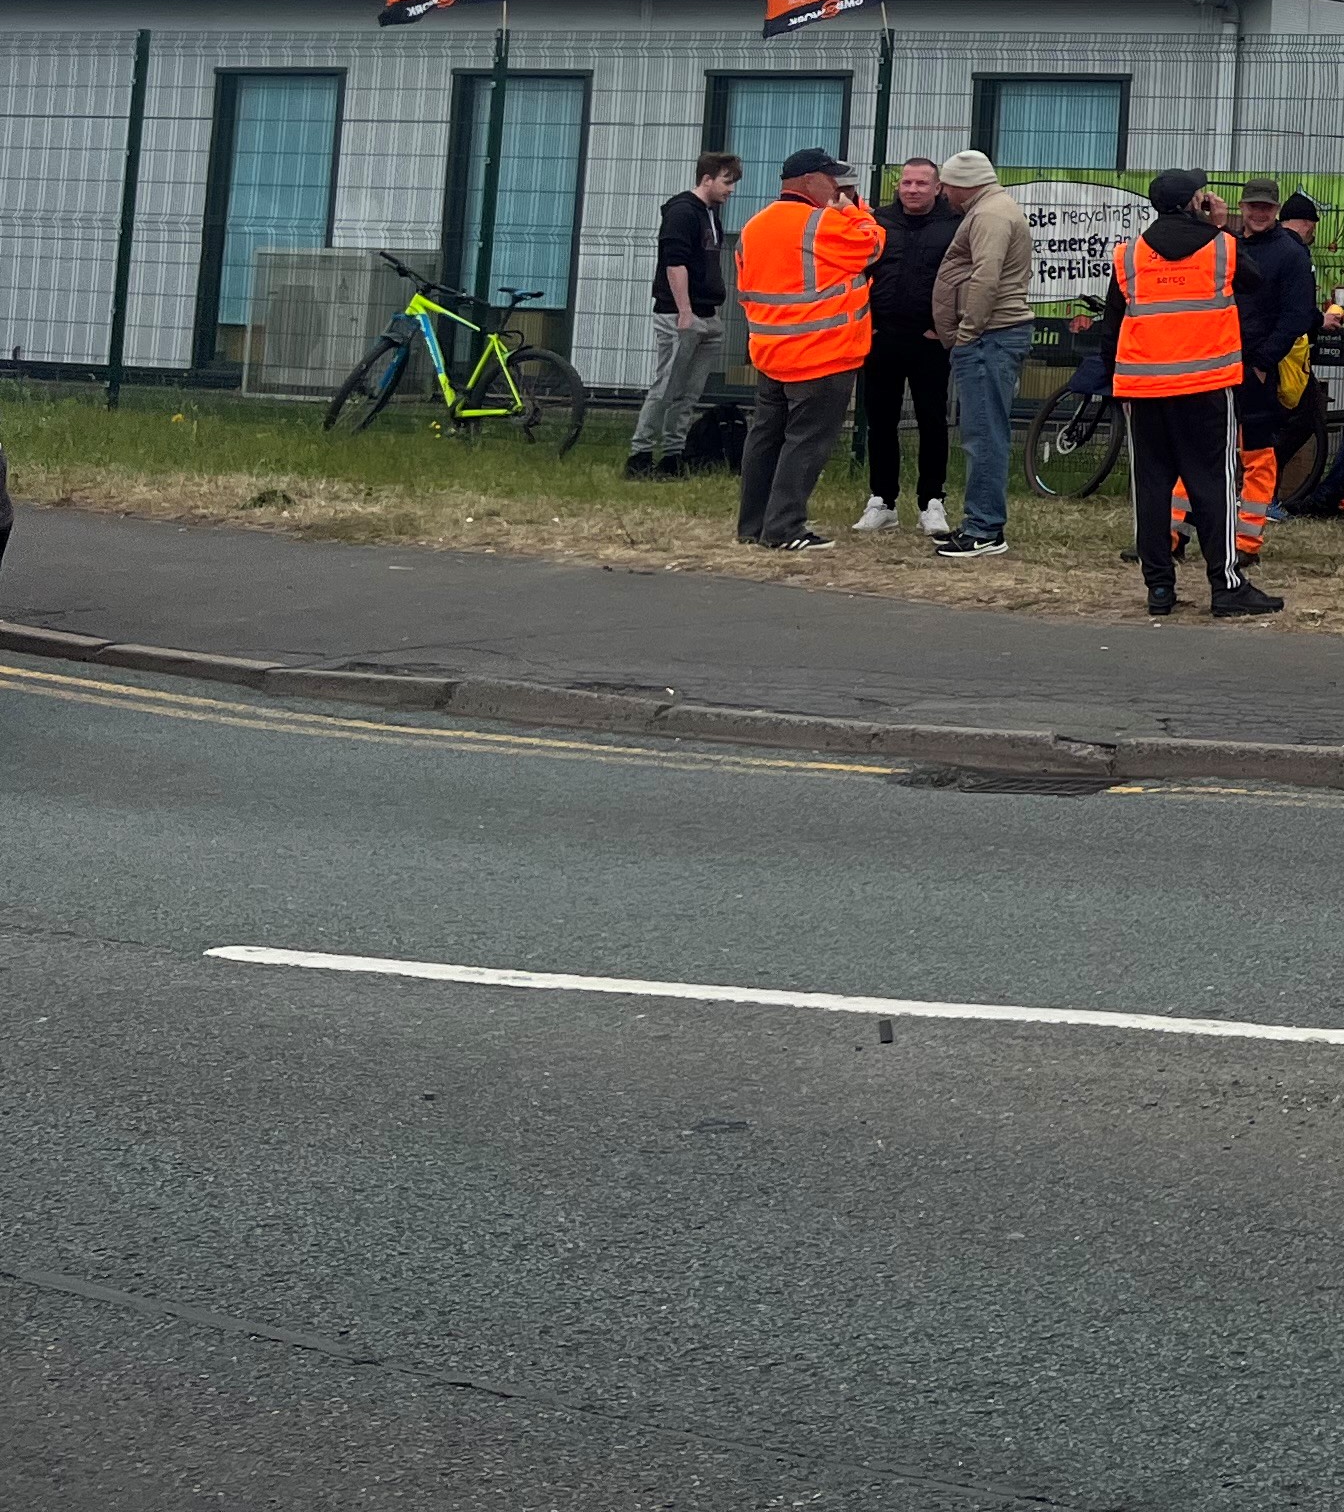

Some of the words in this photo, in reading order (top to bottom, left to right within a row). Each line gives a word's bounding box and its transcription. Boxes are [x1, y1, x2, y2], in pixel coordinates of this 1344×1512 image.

[1062, 202, 1131, 233] recycling
[1137, 204, 1151, 221] is
[1048, 233, 1109, 259] energy
